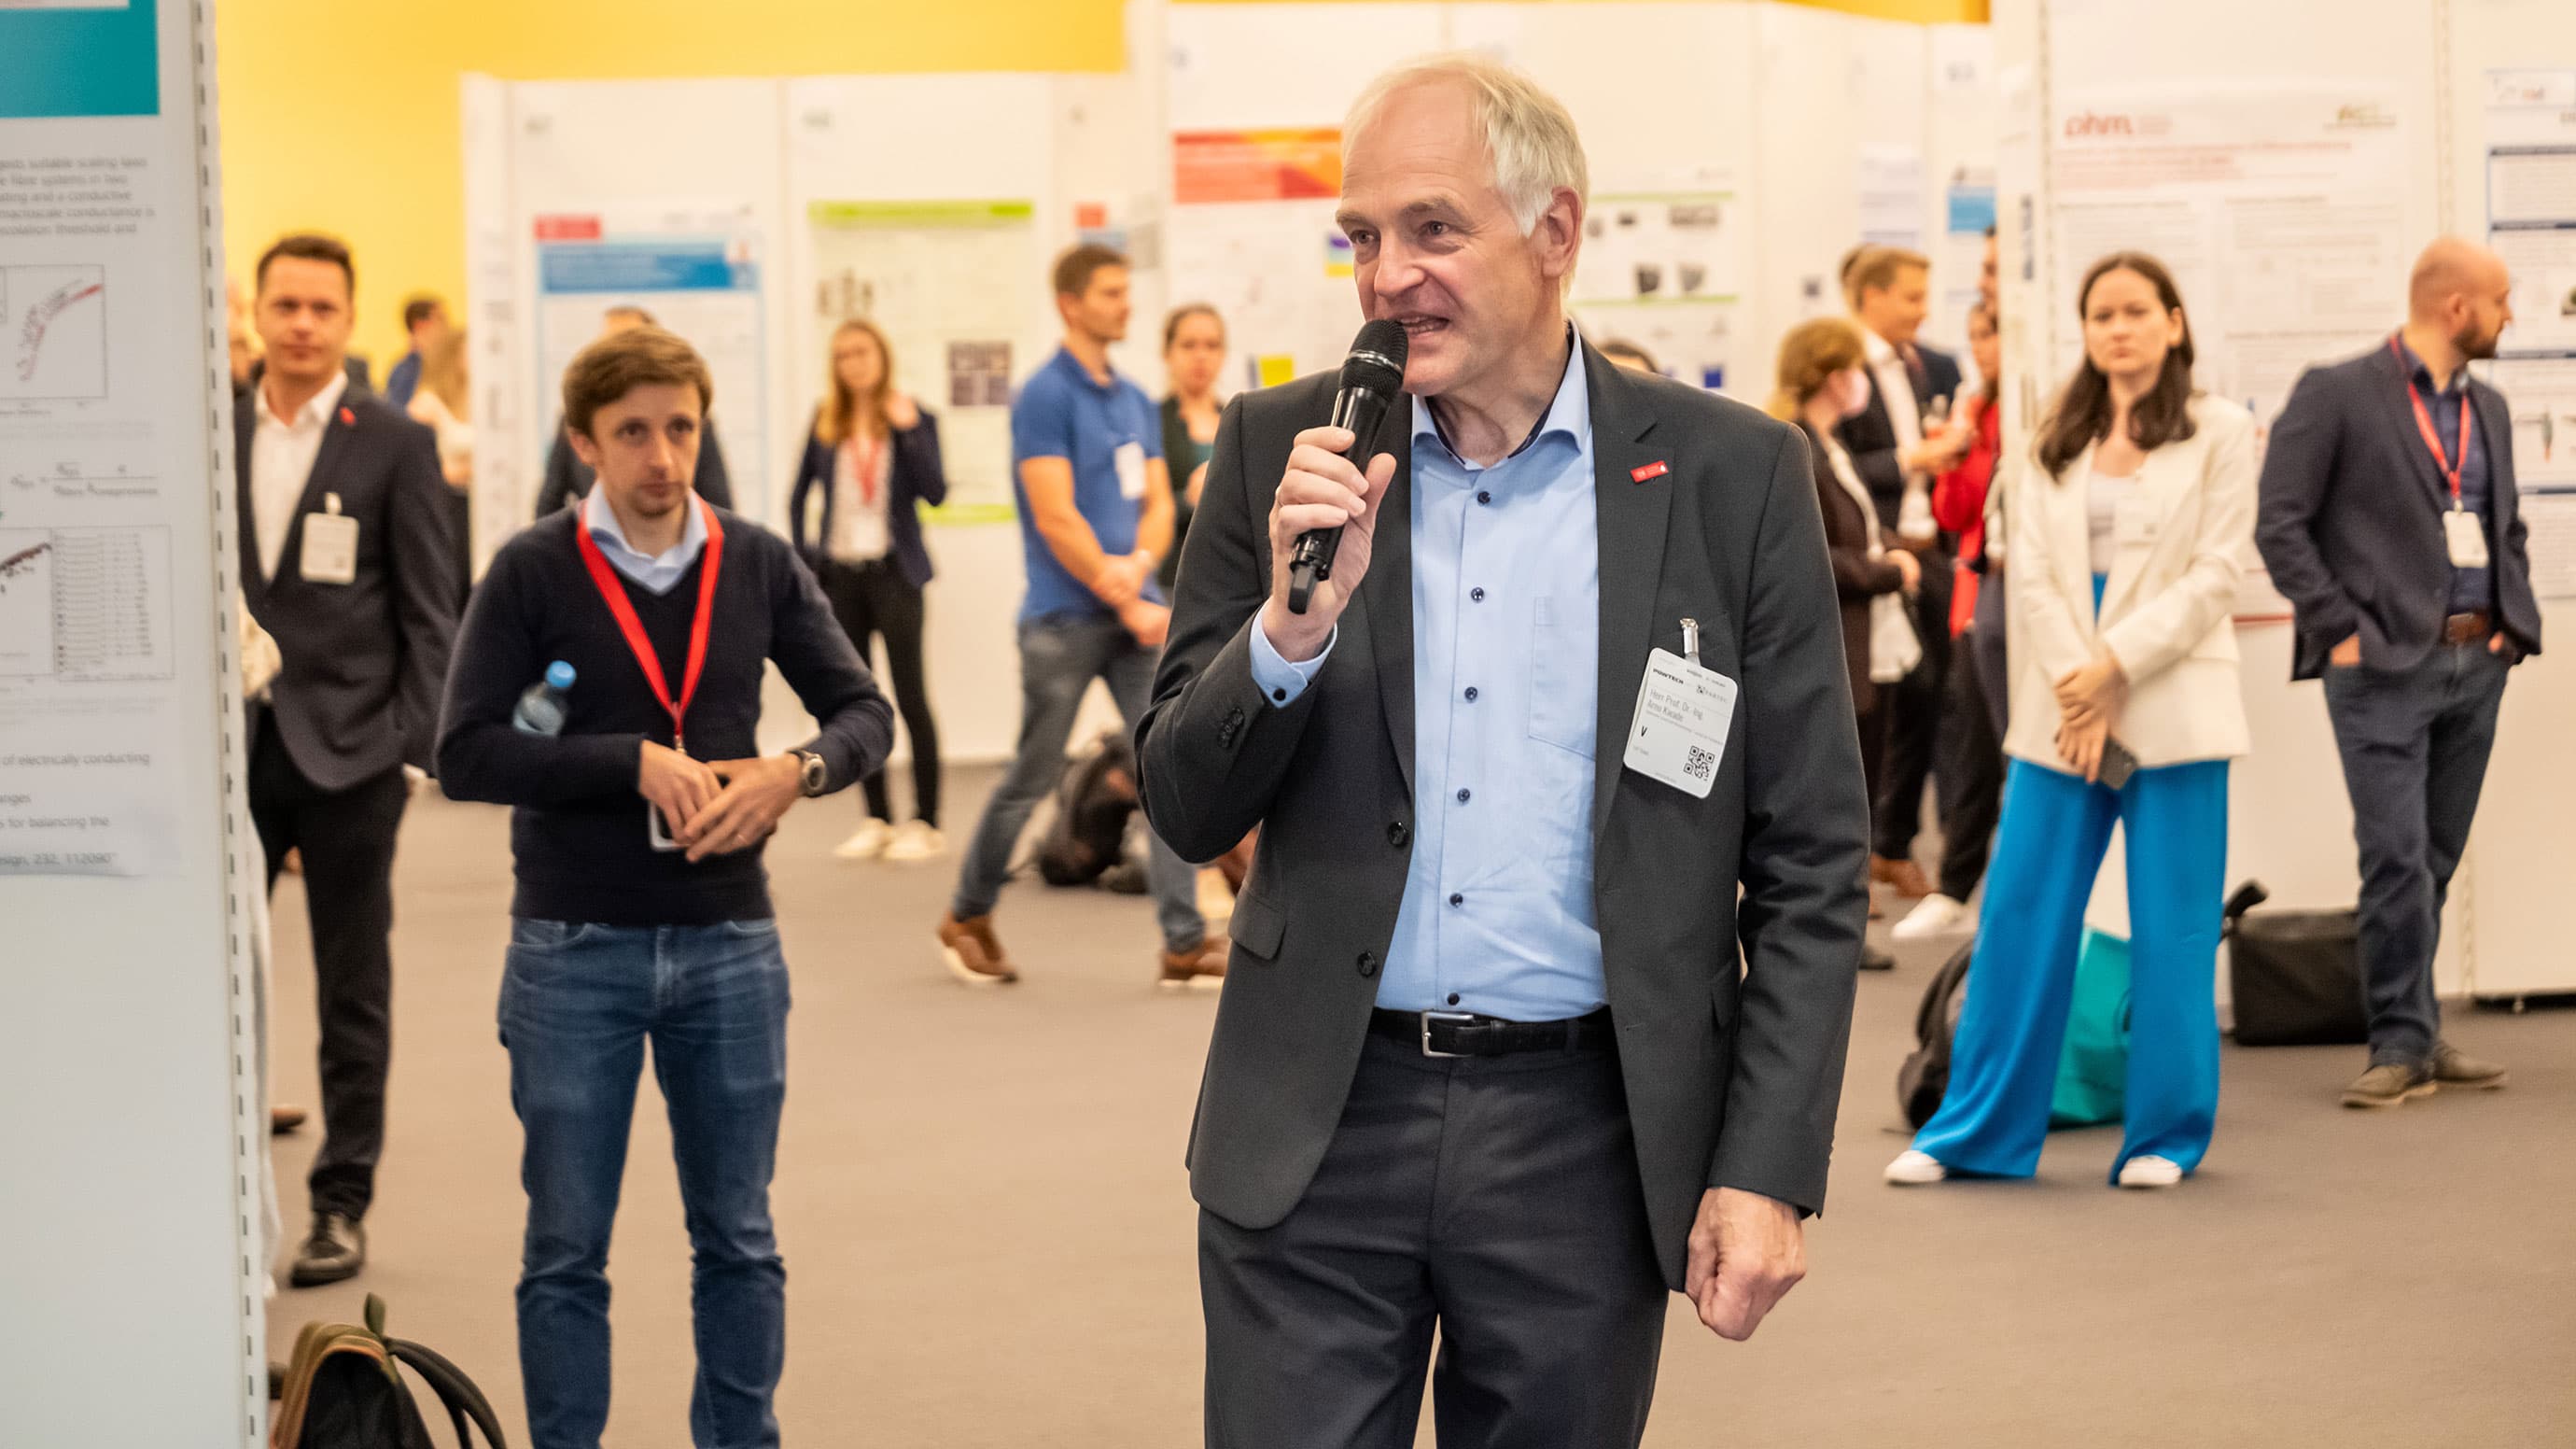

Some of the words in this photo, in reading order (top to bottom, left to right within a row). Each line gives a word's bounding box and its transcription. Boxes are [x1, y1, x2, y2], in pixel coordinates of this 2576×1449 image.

[31, 190, 53, 202] and
[67, 190, 133, 202] conductive
[66, 206, 142, 218] conductance
[55, 223, 110, 234] threshold
[113, 223, 137, 233] and
[1653, 668, 1684, 684] POWTECH
[1650, 689, 1664, 701] Herr
[1641, 724, 1648, 737] V
[2, 753, 16, 766] of
[19, 753, 79, 767] electrically
[83, 752, 150, 767] conducting
[8, 816, 24, 828] for
[29, 815, 86, 830] balancing
[90, 815, 109, 826] the
